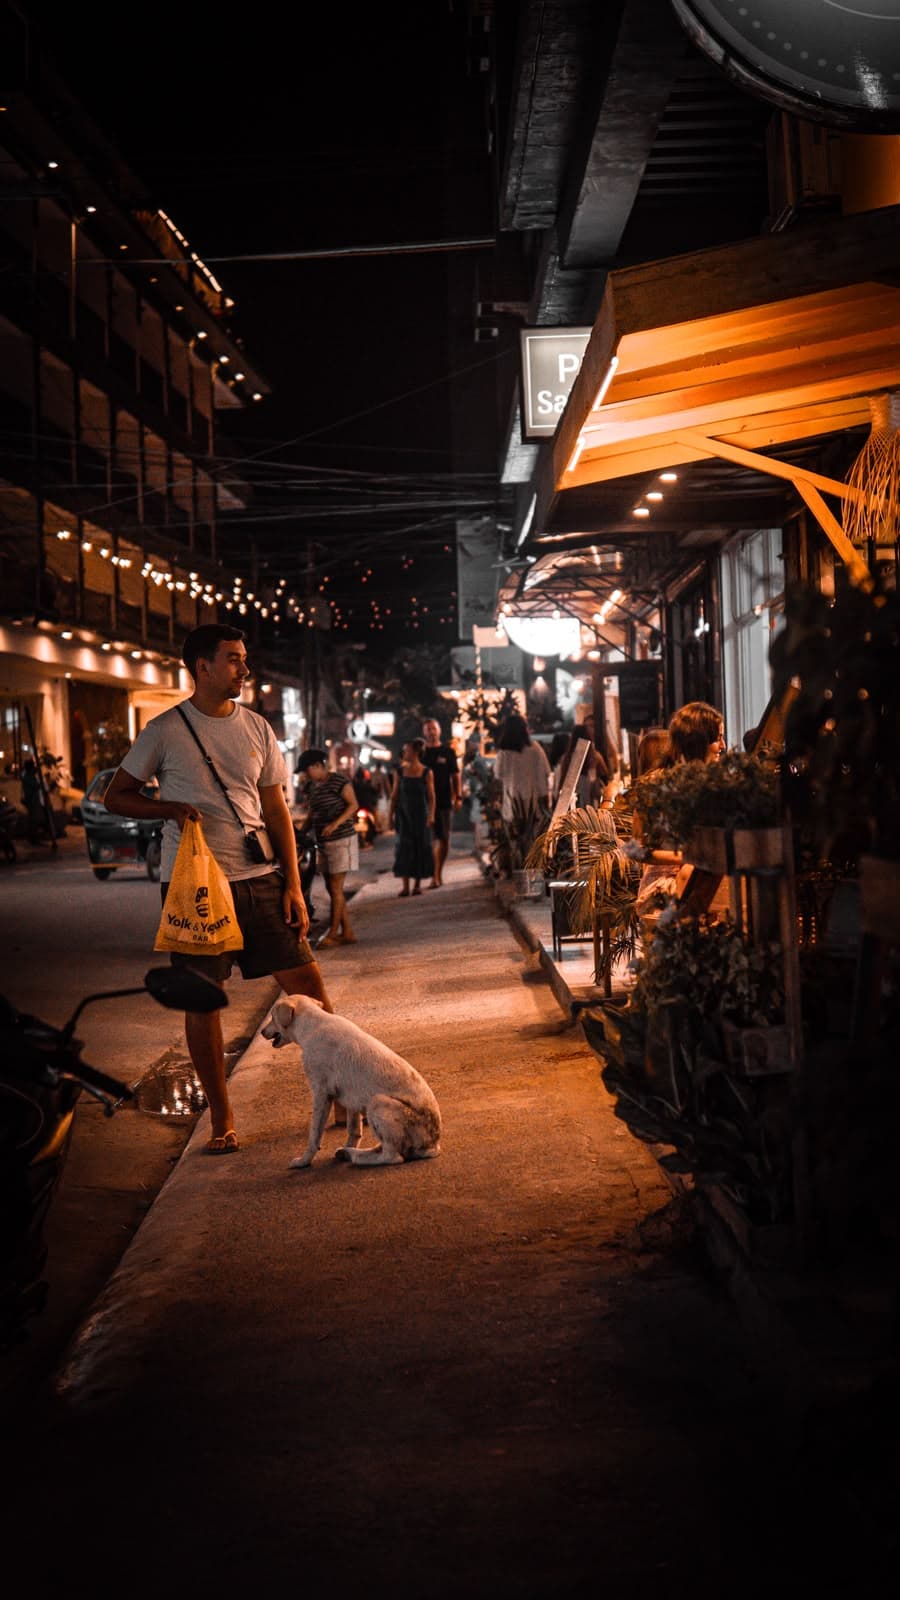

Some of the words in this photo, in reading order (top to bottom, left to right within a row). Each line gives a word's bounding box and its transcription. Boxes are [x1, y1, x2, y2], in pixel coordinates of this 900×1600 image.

[558, 353, 584, 383] P
[537, 390, 571, 414] Sa
[168, 913, 191, 930] Yolk
